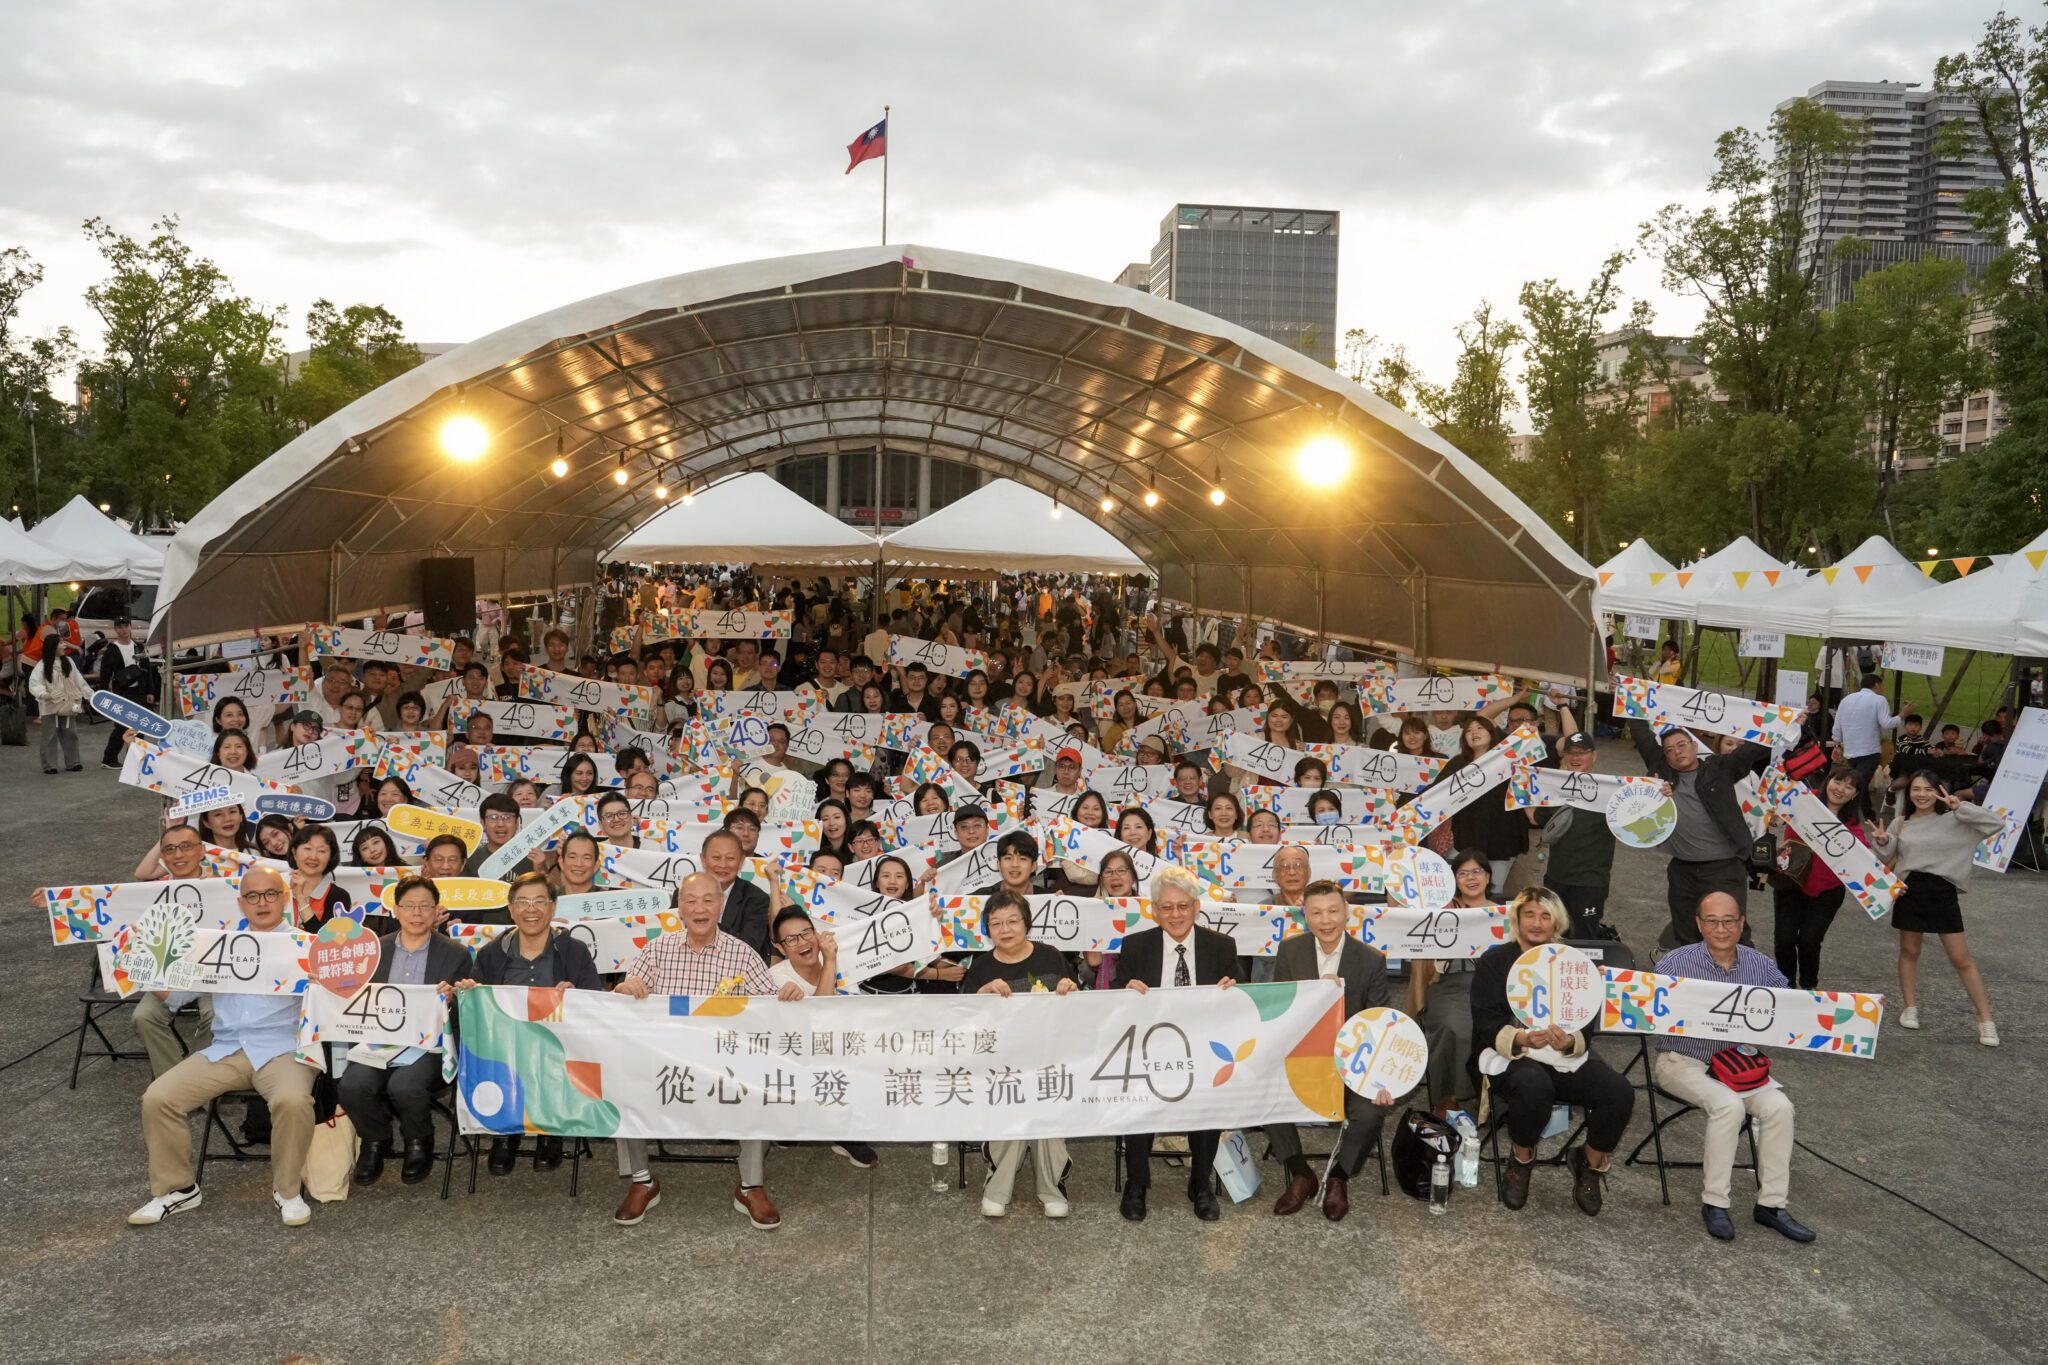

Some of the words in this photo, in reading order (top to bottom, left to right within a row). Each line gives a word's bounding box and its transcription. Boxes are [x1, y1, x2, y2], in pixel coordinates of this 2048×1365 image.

[717, 611, 746, 632] 40
[363, 631, 400, 655] 40
[916, 641, 948, 667] 40
[234, 670, 266, 698] 40
[570, 680, 602, 705] 40
[1418, 677, 1455, 703] 40
[500, 703, 535, 729] 40
[744, 691, 777, 715] 40
[1682, 690, 1726, 724] 40
[729, 717, 769, 746] 40
[833, 714, 866, 739] 40
[790, 727, 824, 754] 40
[284, 742, 323, 771] 40
[1248, 742, 1286, 772] 40
[1362, 753, 1397, 783] 40
[1113, 766, 1148, 792] 40
[1450, 762, 1486, 796] 40
[1561, 772, 1599, 802] 40
[181, 785, 229, 805] TBMS
[276, 800, 328, 816] 術德兼備
[1812, 821, 1856, 858] 40
[1419, 861, 1444, 874] 專業
[1421, 875, 1446, 888] 誠信
[581, 896, 661, 913] 吾日三省吾身
[1425, 889, 1449, 902] 承諾
[1031, 899, 1079, 941] 40
[1406, 910, 1459, 949] 40
[1433, 926, 1460, 934] YEARS
[856, 911, 914, 956] 40
[882, 926, 913, 941] YEARS
[121, 954, 155, 970] 生命的
[198, 933, 261, 981] 40
[229, 955, 261, 964] YEARS
[317, 941, 377, 963] 用生命傳遞
[129, 967, 152, 981] 價值
[1559, 960, 1589, 975] 持續
[1559, 976, 1589, 991] 成長
[342, 984, 406, 1032] 40
[375, 1006, 407, 1015] YEARS
[1560, 991, 1573, 1006] 及
[1709, 985, 1776, 1032] 40
[1743, 1006, 1776, 1016] YEARS
[335, 1023, 379, 1031] ANNIVERSARY
[1559, 1006, 1590, 1022] 進步
[1701, 1021, 1744, 1030] ANNIVERSARY
[713, 1028, 997, 1057] 博而美國際40周年慶
[1712, 1026, 1729, 1034] TBMS
[1090, 1022, 1194, 1102] 40
[1143, 1058, 1195, 1072] YEARS
[1388, 1034, 1426, 1064] 團隊
[1380, 1056, 1417, 1084] 合作
[655, 1065, 851, 1107] 從心出發
[884, 1063, 1075, 1107] 讓美流動
[1081, 1095, 1150, 1105] ANNIVERSARY
